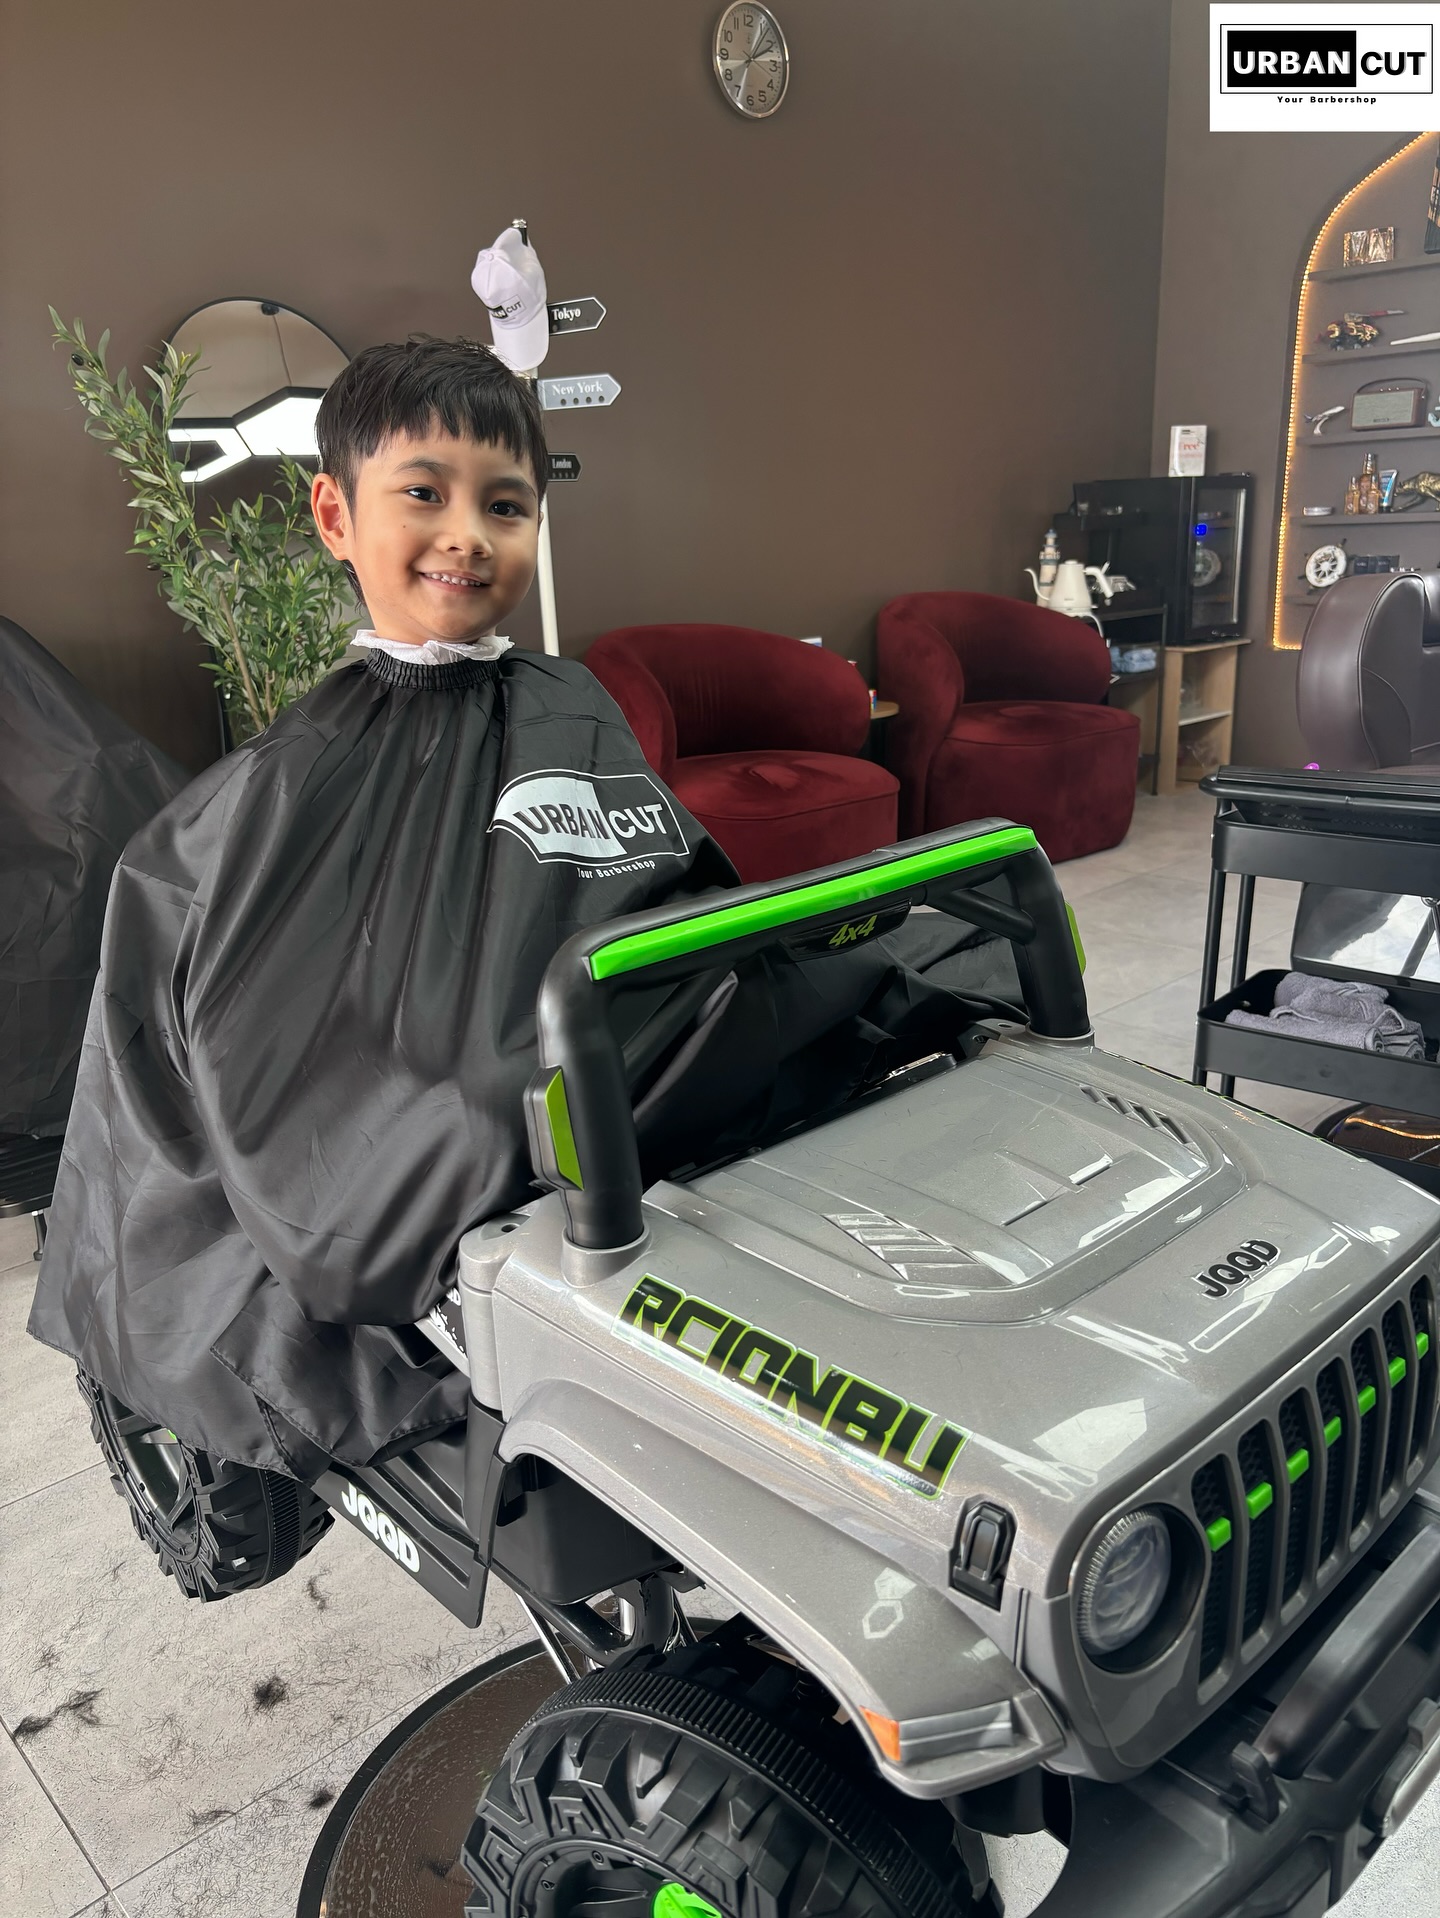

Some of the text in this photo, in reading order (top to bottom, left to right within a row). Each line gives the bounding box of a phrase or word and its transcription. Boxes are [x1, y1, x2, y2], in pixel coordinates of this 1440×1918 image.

[733, 17, 739, 30] 11
[744, 14, 754, 28] 12
[723, 29, 733, 43] 10
[720, 48, 729, 60] 9
[769, 59, 778, 73] 3
[724, 68, 733, 81] 8
[734, 84, 741, 98] 7
[767, 78, 774, 91] 4
[746, 95, 754, 106] 6
[758, 90, 767, 103] 5
[506, 301, 522, 313] CUT
[551, 307, 581, 322] Tokyo
[552, 381, 604, 396] New York
[551, 458, 572, 470] London
[512, 803, 668, 840] URBAN CUT
[577, 859, 656, 879] Your Barbershop
[828, 914, 878, 947] 4x4
[1194, 1239, 1279, 1298] JQQD
[341, 1482, 421, 1573] JQQD
